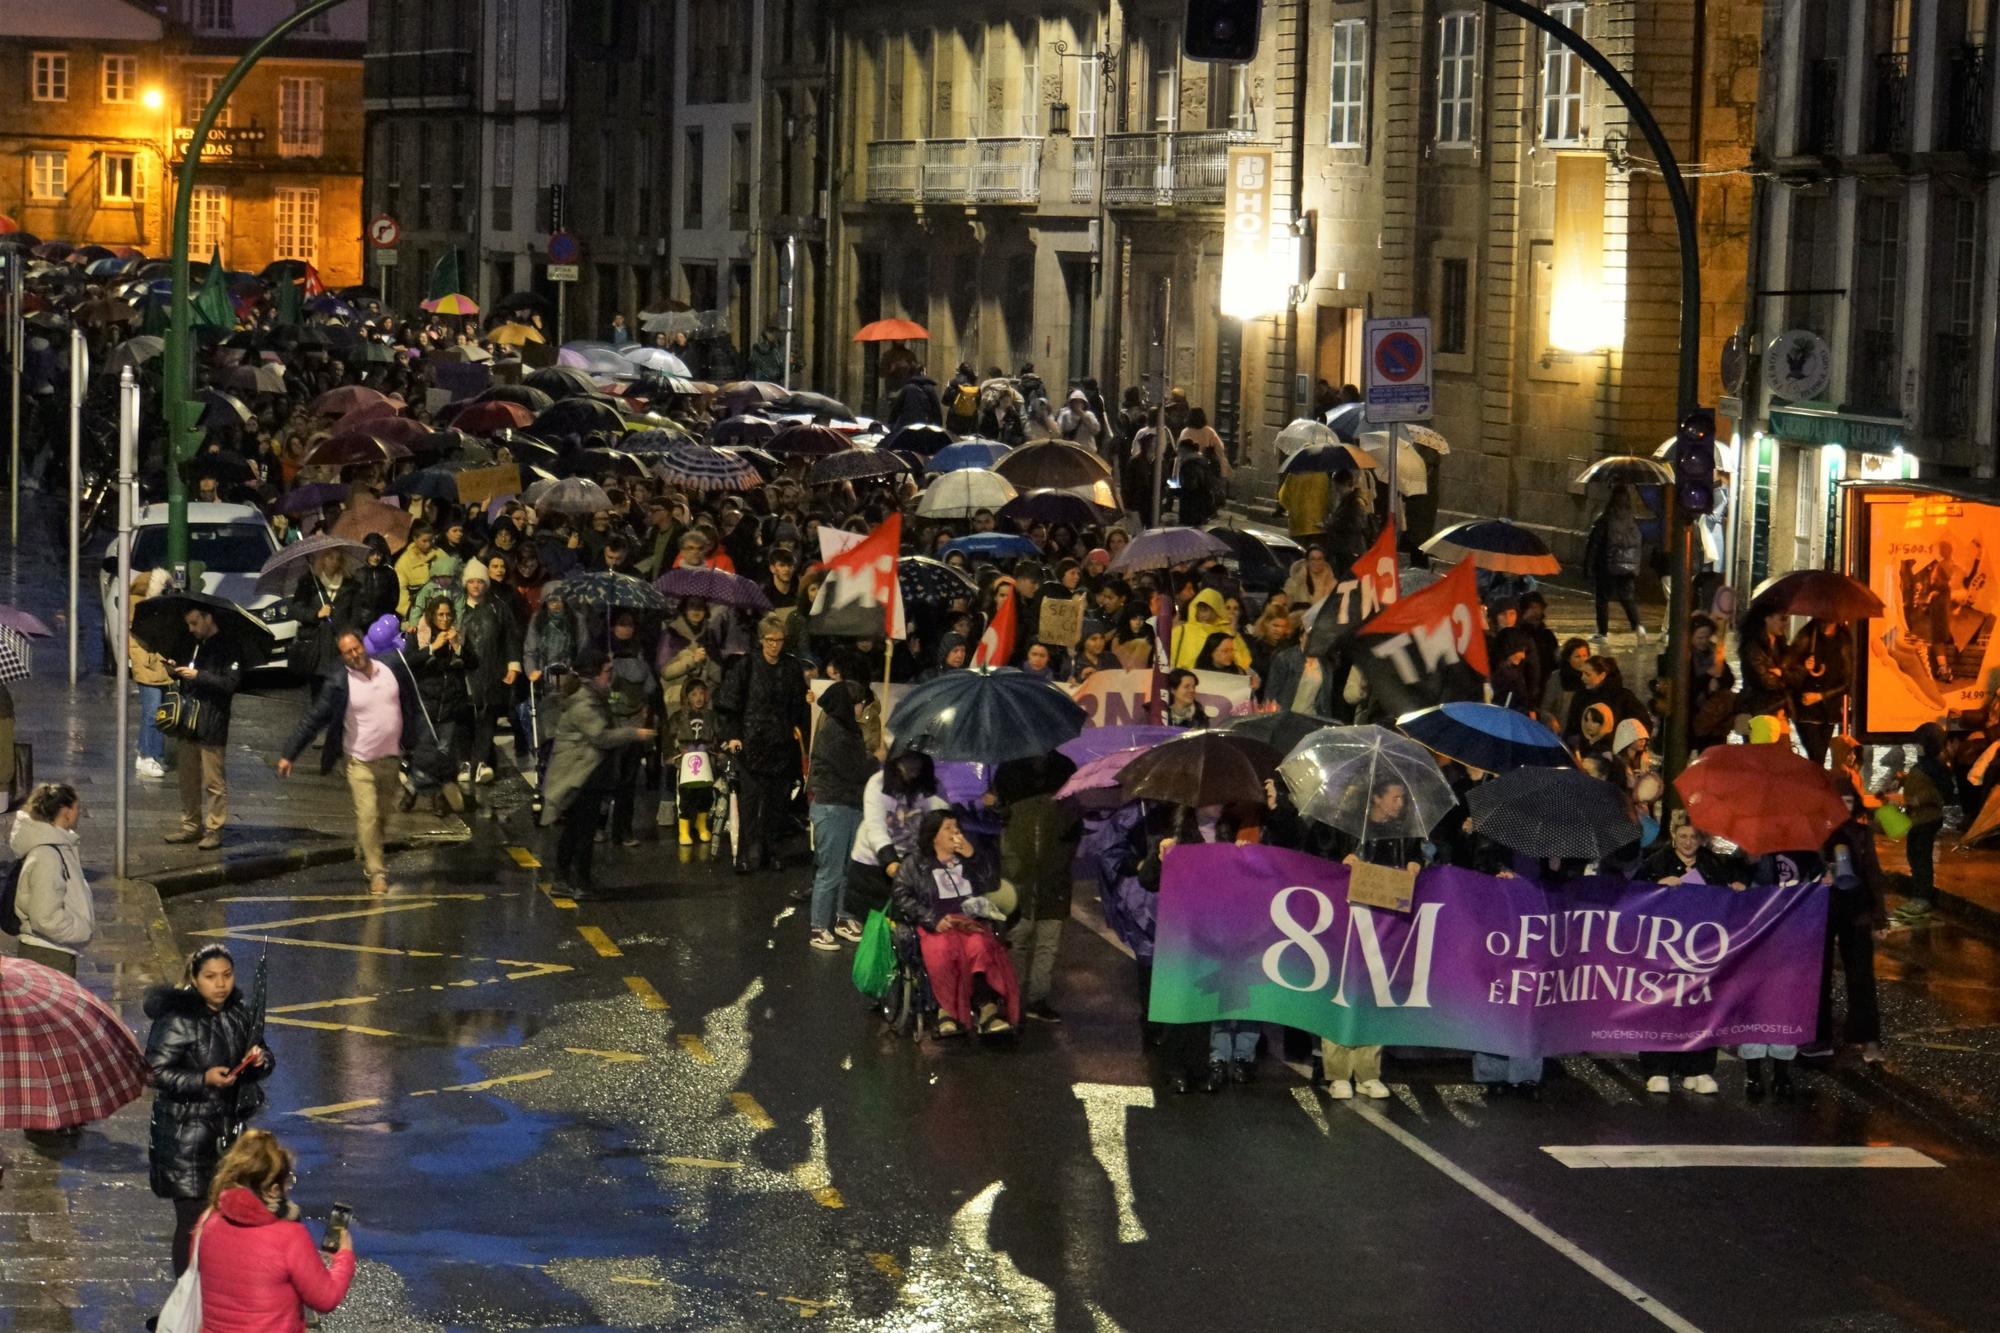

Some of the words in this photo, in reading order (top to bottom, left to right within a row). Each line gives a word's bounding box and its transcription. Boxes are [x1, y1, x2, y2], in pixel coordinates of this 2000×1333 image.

[1262, 886, 1445, 1008] 8M
[1515, 910, 1730, 973] FUTURO
[1508, 964, 1713, 1007] FEMINISTA
[1591, 1030, 1658, 1041] MOVEMENTO
[1660, 1029, 1714, 1042] FEMINISTA
[1731, 1023, 1803, 1036] COMPOSTELA
